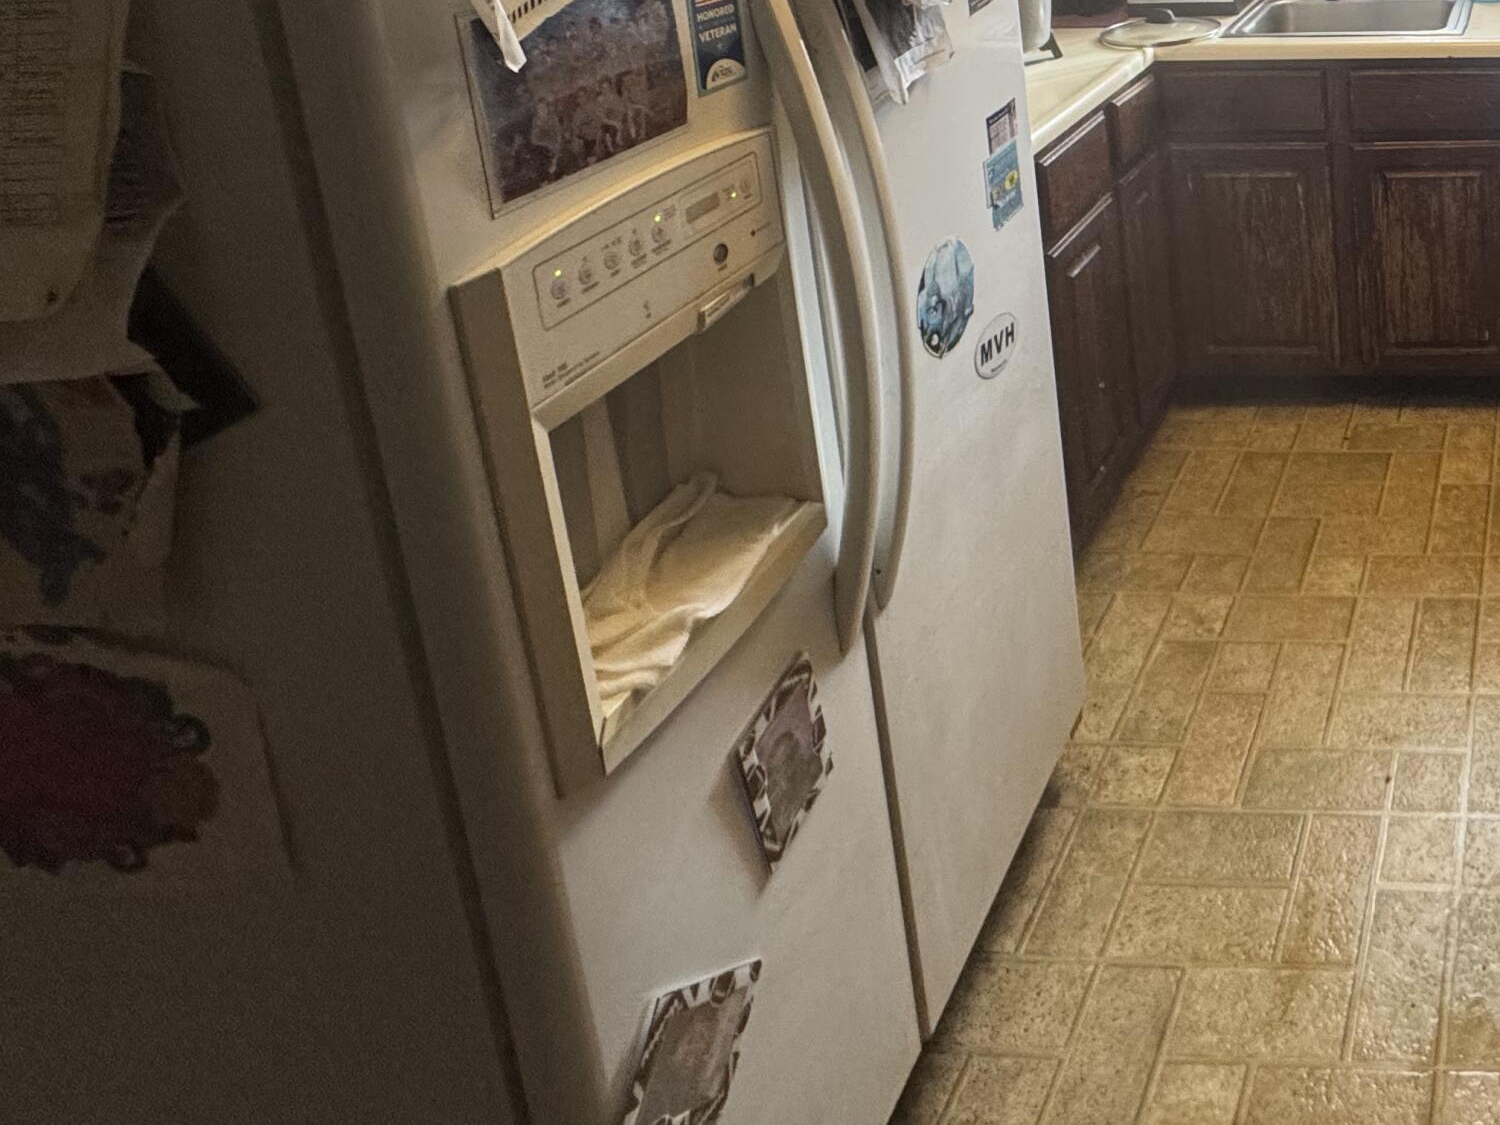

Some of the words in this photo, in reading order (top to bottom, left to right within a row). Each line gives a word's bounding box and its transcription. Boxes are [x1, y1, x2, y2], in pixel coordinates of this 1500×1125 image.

[696, 4, 735, 23] HONORED
[698, 23, 737, 43] VETERAN
[981, 322, 1014, 367] MVH
